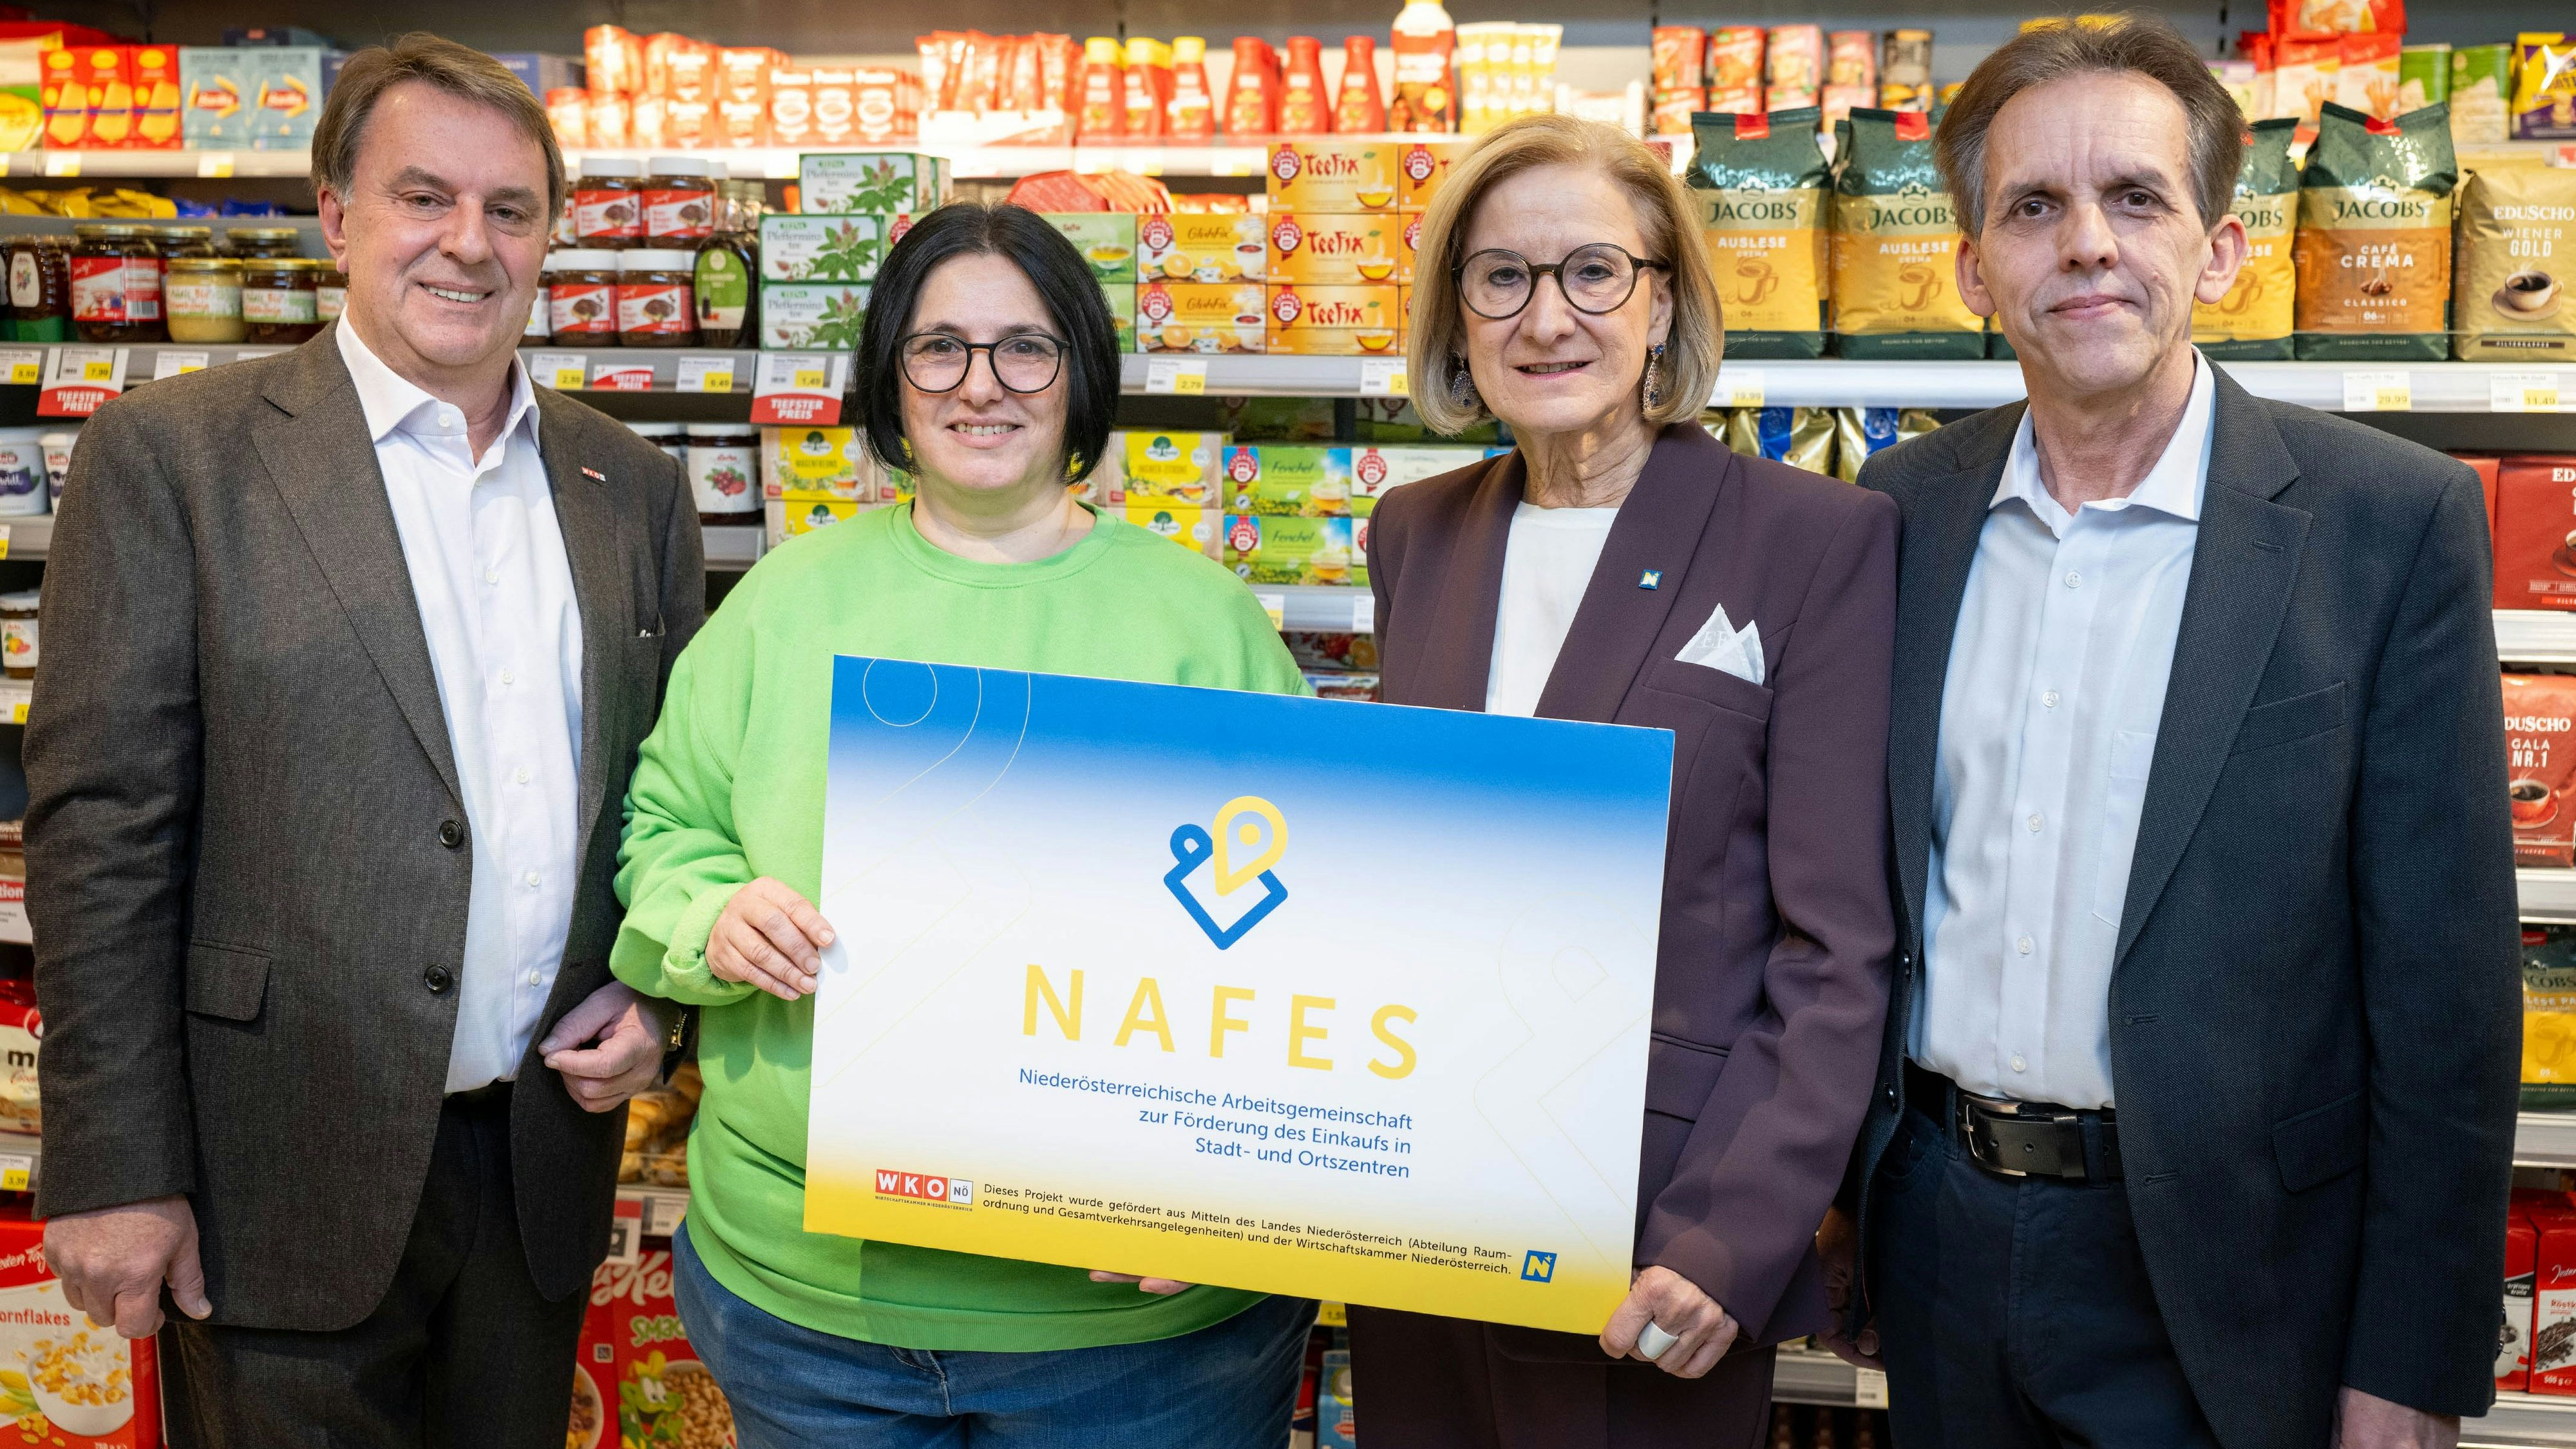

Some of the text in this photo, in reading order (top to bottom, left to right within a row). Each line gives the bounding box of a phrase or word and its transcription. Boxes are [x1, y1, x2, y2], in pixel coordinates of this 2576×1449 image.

[1709, 202, 1797, 223] JACOBS
[2332, 199, 2425, 222] JACOBS
[2494, 205, 2575, 221] EDUSCHO
[2503, 227, 2562, 240] WIENER
[1718, 236, 1787, 249] AUSLESE
[1879, 240, 1950, 254] AUSLESE
[2360, 242, 2397, 255] CAFÉ
[2510, 240, 2552, 257] GOLD
[2340, 254, 2414, 269] CREMA
[2344, 298, 2407, 307] CLASSICO
[612, 373, 650, 383] TIEFSTER
[57, 390, 104, 402] TIEFSTER
[771, 398, 824, 410] TIEFSTER
[62, 401, 95, 412] PREIS
[777, 409, 814, 419] PREIS
[2505, 716, 2571, 732] DUSCHO
[2512, 738, 2550, 750] GALA
[2512, 750, 2548, 768] NR.1
[1022, 963, 1419, 1081] NAFES
[1019, 1068, 1412, 1130] Niederösterreichische Arbeitsgemeinschaft
[1139, 1110, 1411, 1154] zur Förderung des Einkaufs in
[1195, 1137, 1409, 1178] Stadt- und Ortszentren
[877, 1172, 969, 1198] WKO NÖ
[875, 1195, 972, 1212] WIRTSCHAFTSKAMMER NIEDERÖSTERREICH
[984, 1184, 1512, 1260] Dieses Projekt wurde gefördert aus Mitteln des Landes Niederösterreich (Abteilung Raum-
[983, 1199, 1511, 1274] ordnung und Gesamtverkehrsangelegenheiten) und der Wirtschaftskammer Niederösterreich.
